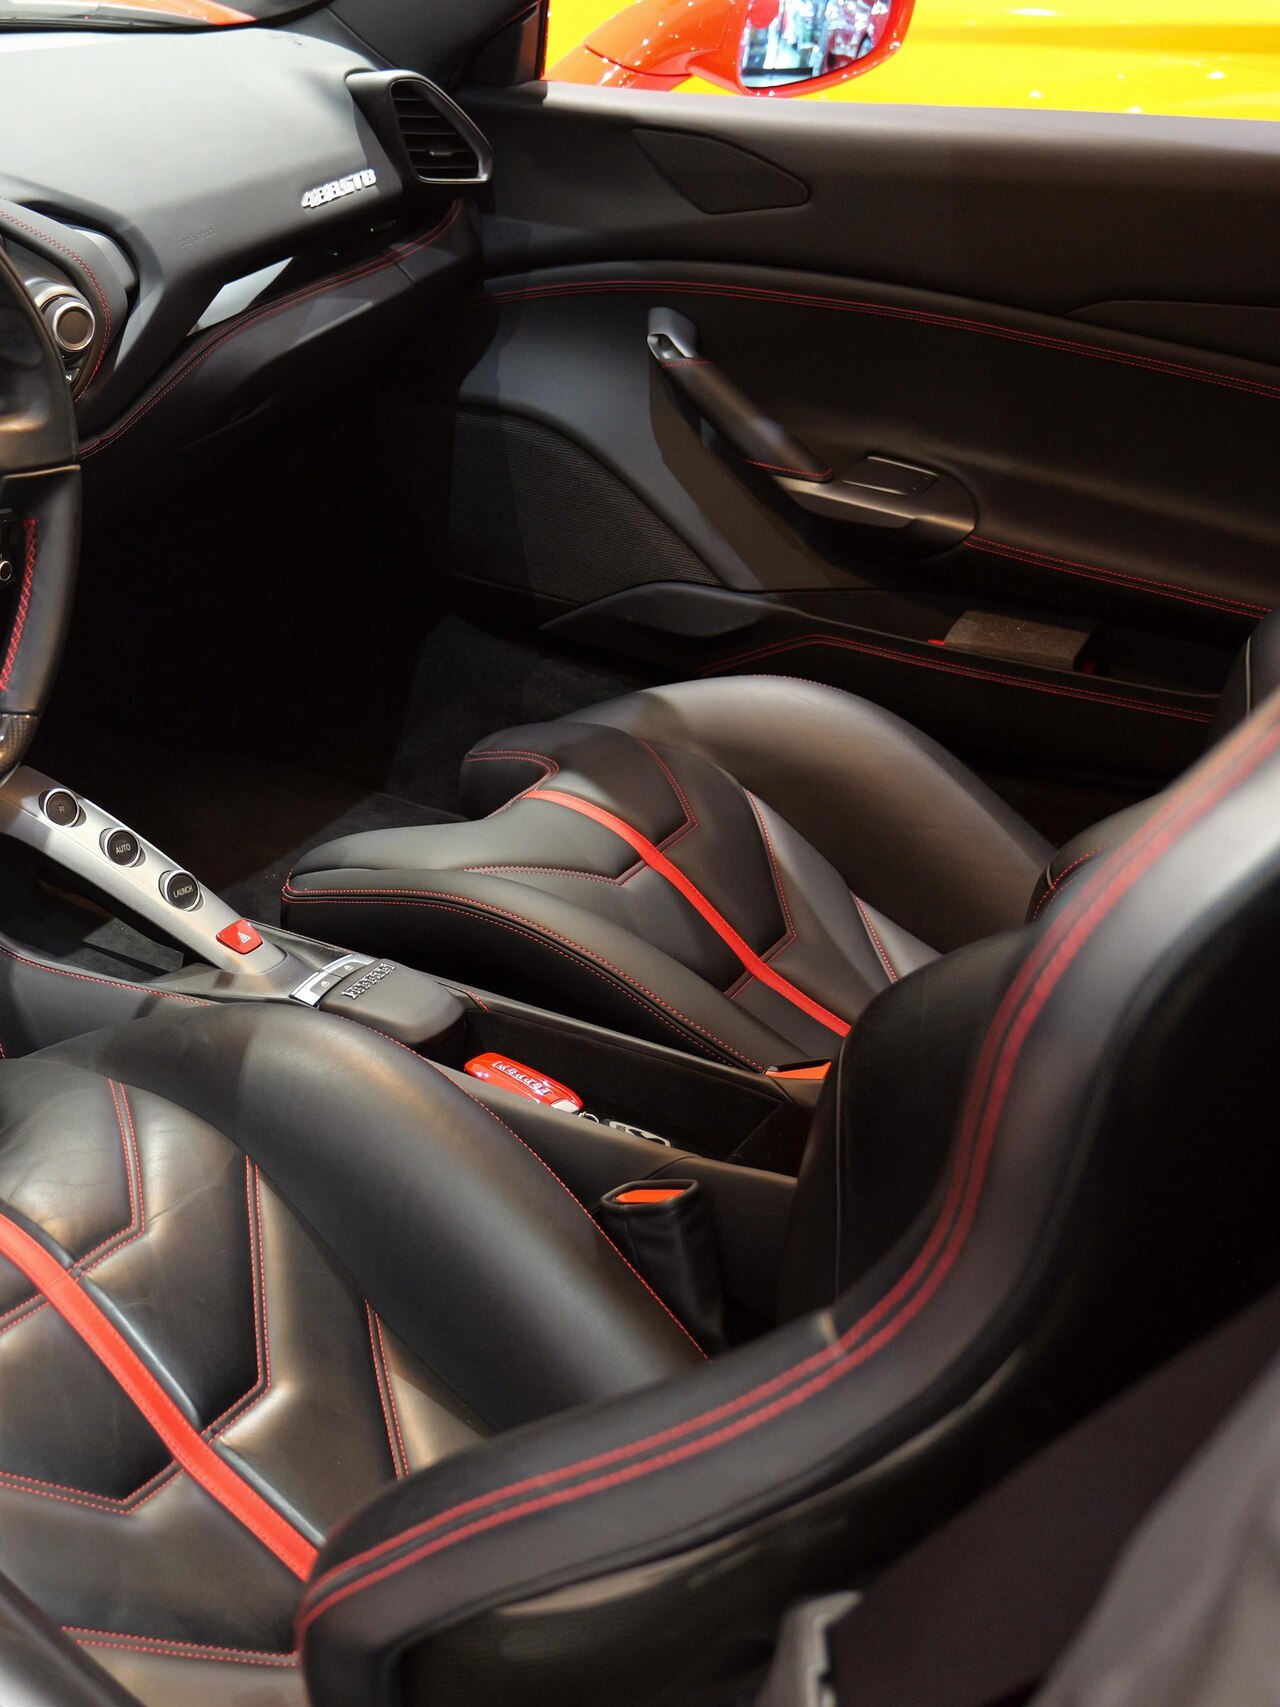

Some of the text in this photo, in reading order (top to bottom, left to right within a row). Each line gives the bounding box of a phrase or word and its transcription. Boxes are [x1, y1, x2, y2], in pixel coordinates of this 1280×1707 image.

[58, 805, 66, 814] R
[115, 842, 132, 855] AUTO
[172, 884, 194, 898] LAUNCH
